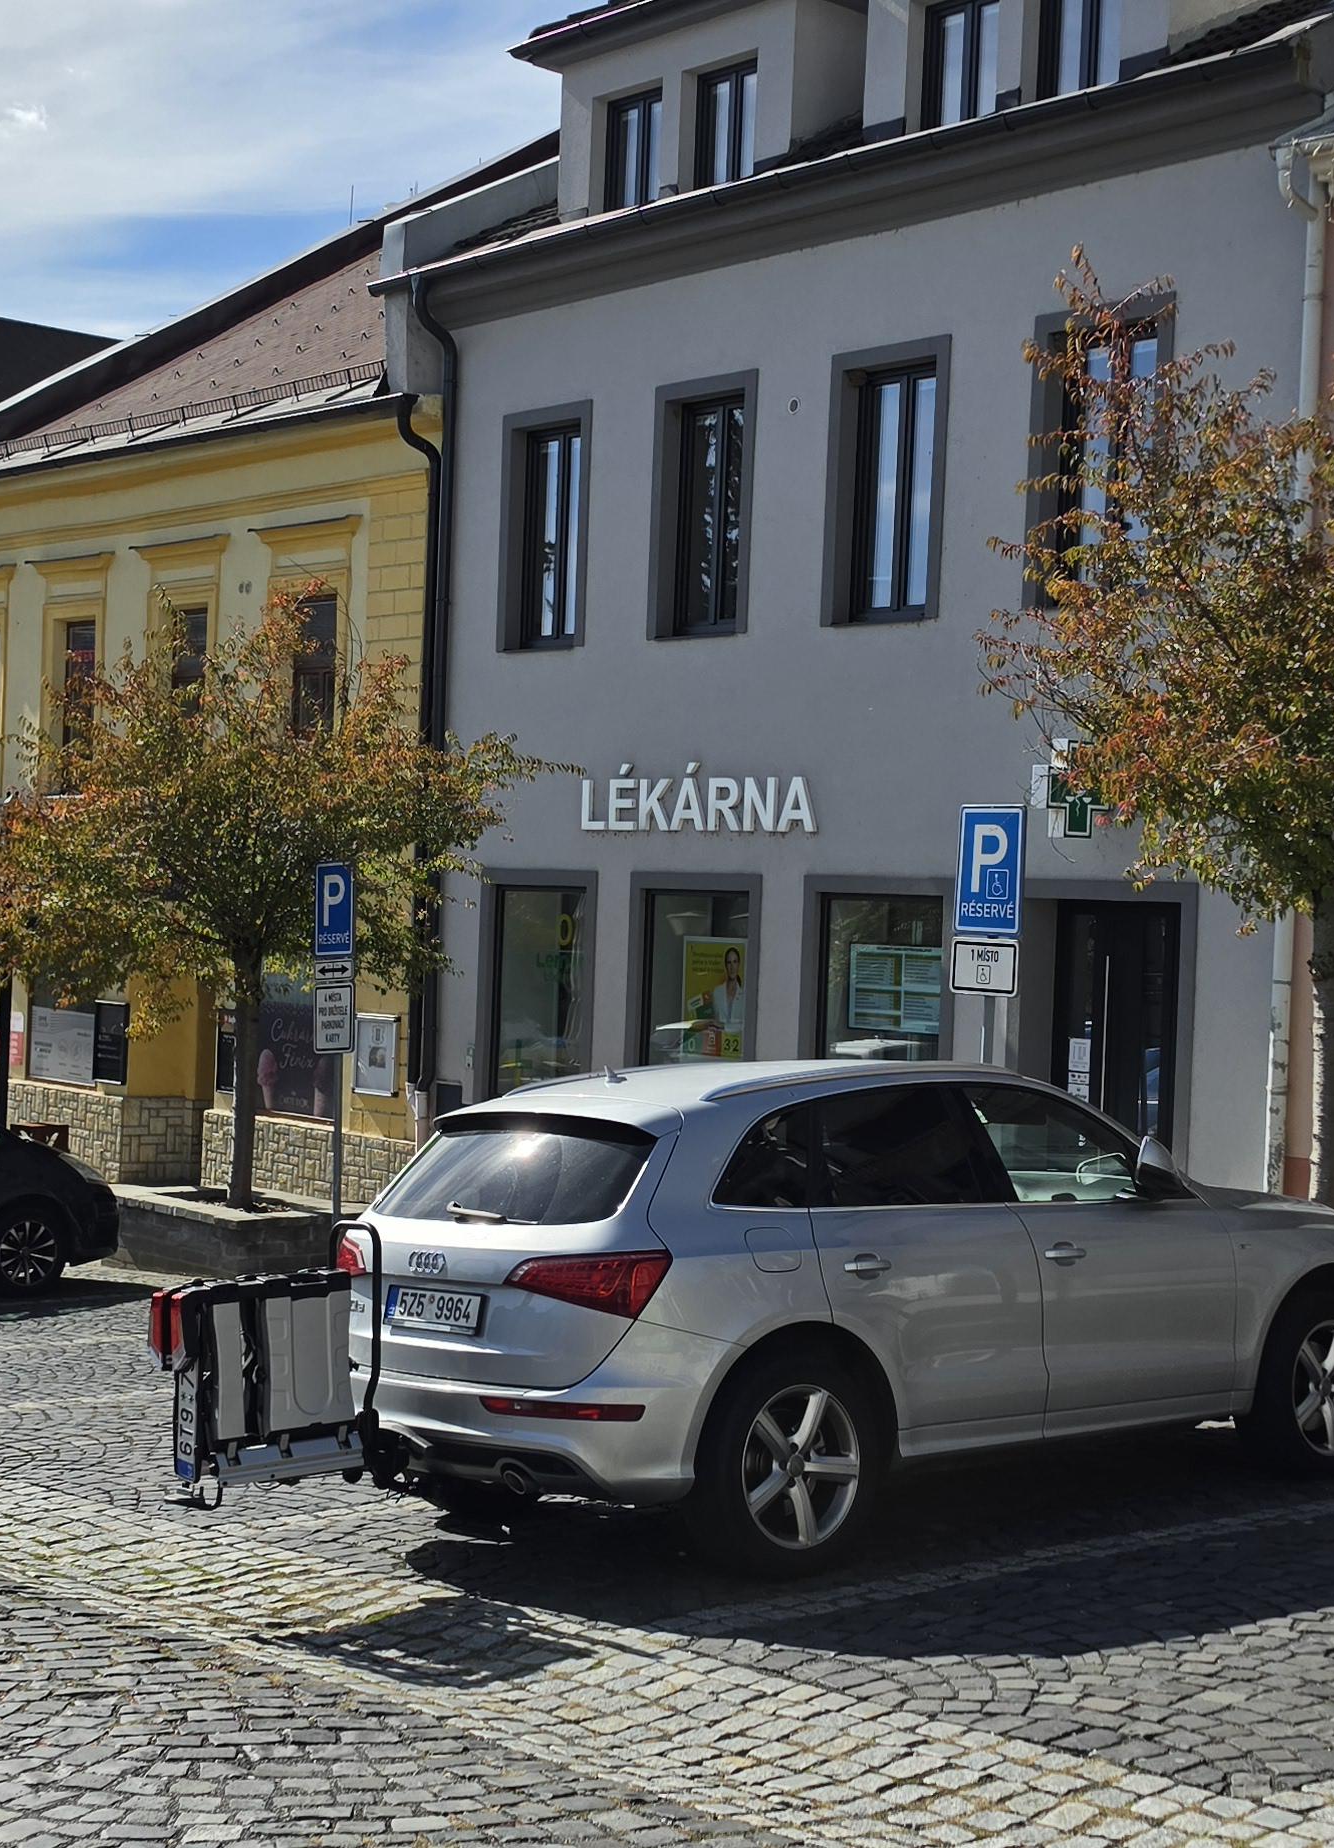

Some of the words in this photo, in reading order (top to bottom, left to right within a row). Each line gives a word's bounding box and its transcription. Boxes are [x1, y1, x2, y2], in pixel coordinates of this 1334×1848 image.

[581, 761, 818, 833] LÉKÁRNA
[970, 823, 1009, 893] P
[323, 874, 346, 927] P
[960, 899, 1015, 919] RÉSERVÉ
[318, 930, 350, 945] RÉSERVÉ
[970, 949, 975, 962] 1
[976, 947, 1000, 963] MÍSTO
[398, 1291, 427, 1318] 5Z5
[434, 1295, 473, 1324] 9964
[179, 1407, 194, 1456] 6T9
